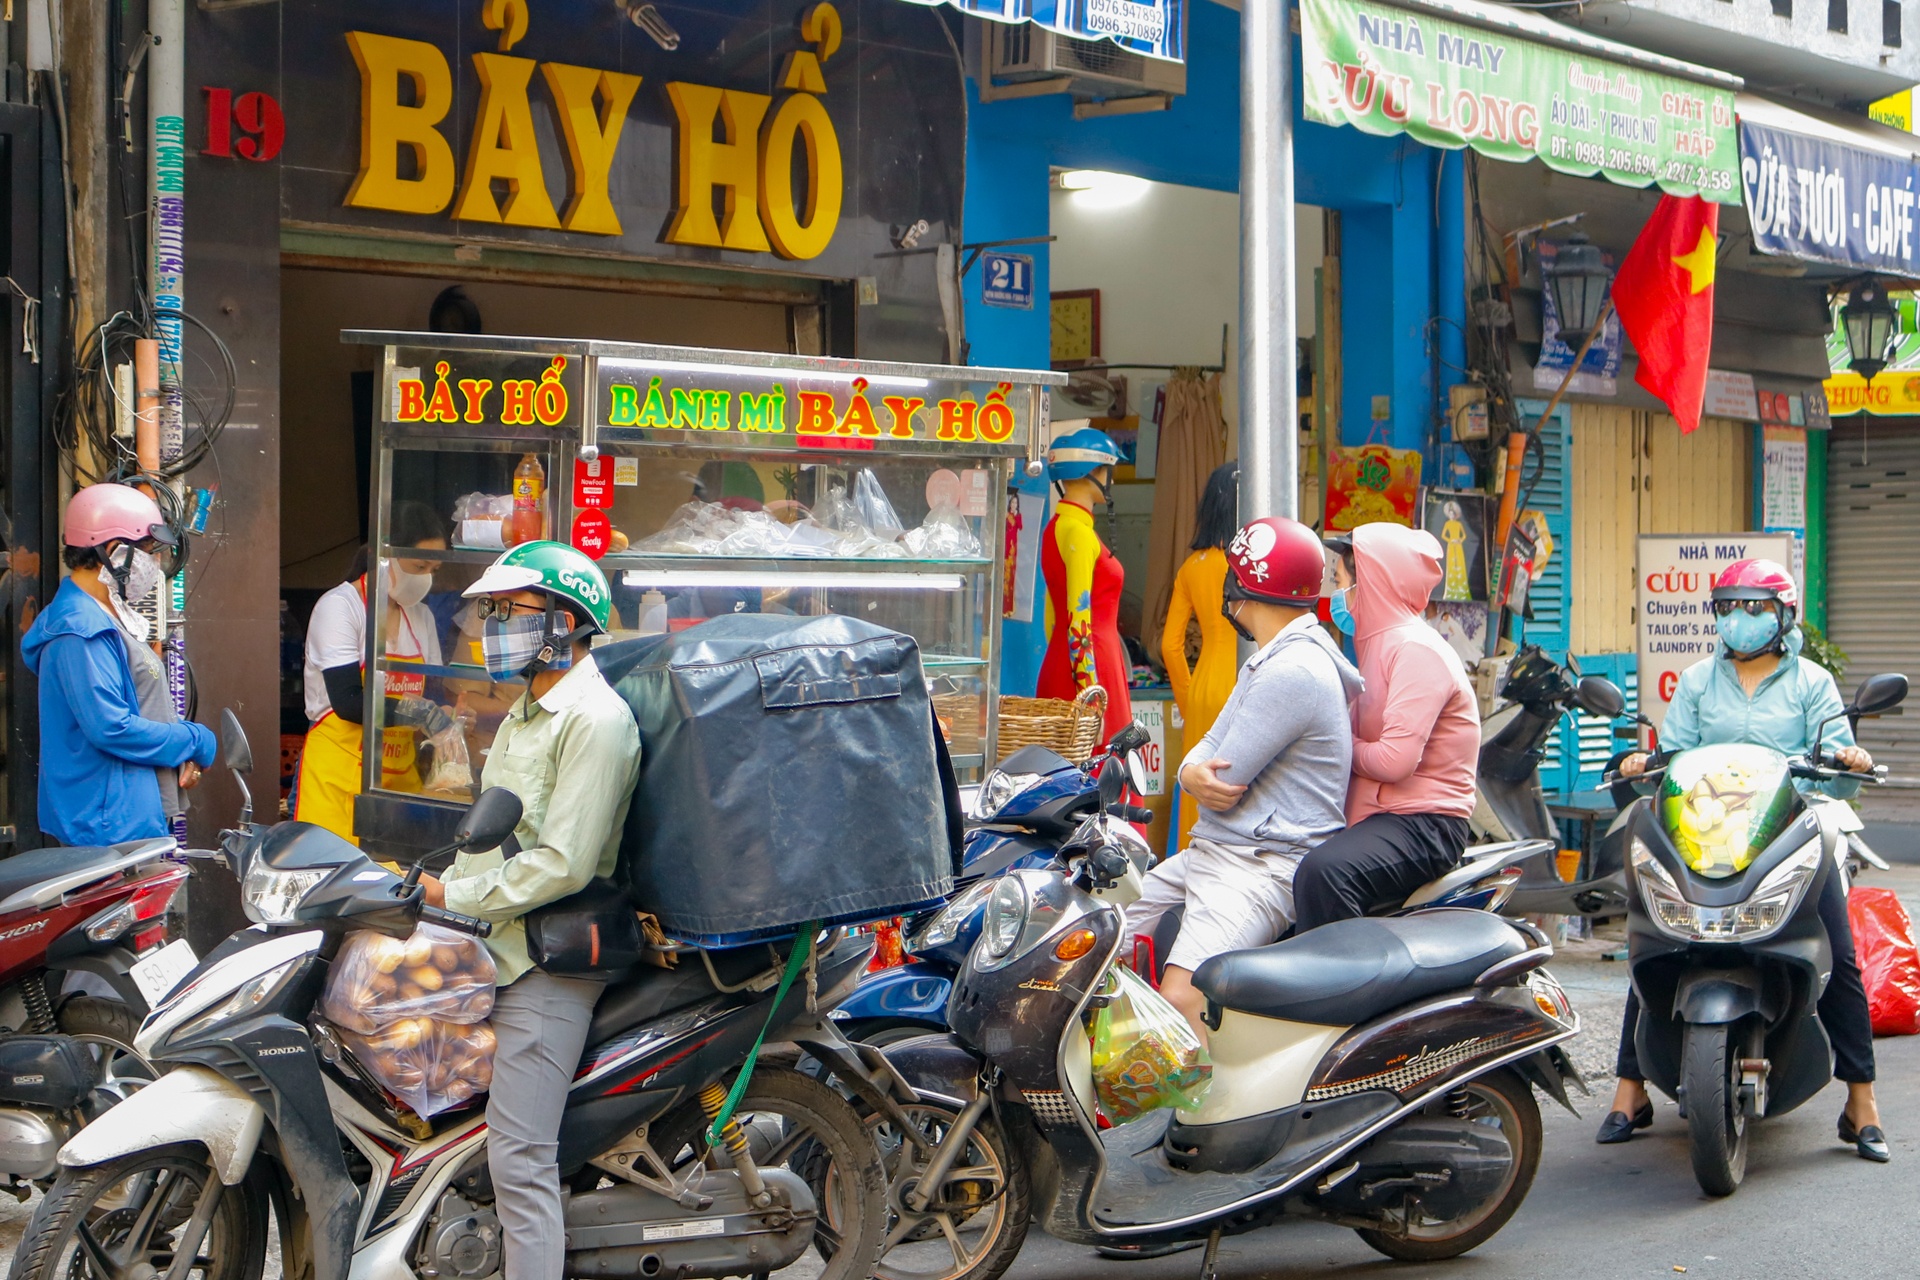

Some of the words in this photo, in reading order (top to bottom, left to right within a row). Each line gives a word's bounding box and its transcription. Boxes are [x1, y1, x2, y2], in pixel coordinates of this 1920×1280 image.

[1090, 14, 1163, 43] 0986.370892
[1358, 14, 1424, 56] NHÀ
[1438, 32, 1504, 74] MAY
[200, 86, 285, 162] 19
[1425, 83, 1541, 149] LONG
[1551, 94, 1568, 124] ÁO
[1571, 101, 1590, 131] DÀI
[1599, 111, 1607, 134] Y
[1610, 113, 1640, 144] PHỤC
[1642, 116, 1658, 144] NỮ
[1661, 92, 1705, 125] GIẶT
[1712, 96, 1731, 128] ỦI
[343, 0, 642, 236] BẢY
[664, 2, 842, 260] HỔ
[1675, 127, 1715, 157] HẤP
[1551, 136, 1572, 160] ĐT:
[1574, 141, 1657, 176] 0983.205.694
[1741, 145, 1790, 239] SỮA
[1797, 165, 1846, 249] TƯƠI
[1865, 176, 1915, 261] CAFÉ
[991, 259, 1024, 290] 21
[397, 361, 492, 424] BẢY
[501, 354, 568, 425] HỔ
[609, 376, 732, 431] BÁNH
[738, 383, 786, 433] MÌ
[796, 377, 925, 438] BẢY
[936, 381, 1014, 443] HỔ
[581, 536, 602, 549] Foody
[1679, 542, 1709, 560] NHÀ
[1714, 545, 1747, 560] MAY
[558, 569, 600, 605] Grab
[1646, 566, 1700, 594] CỬU
[1647, 600, 1697, 618] Chuyên
[1646, 622, 1699, 636] TAILOR'S
[1649, 641, 1702, 654] LAUNDRY
[258, 1045, 306, 1057] HONDA
[641, 1072, 659, 1088] FI
